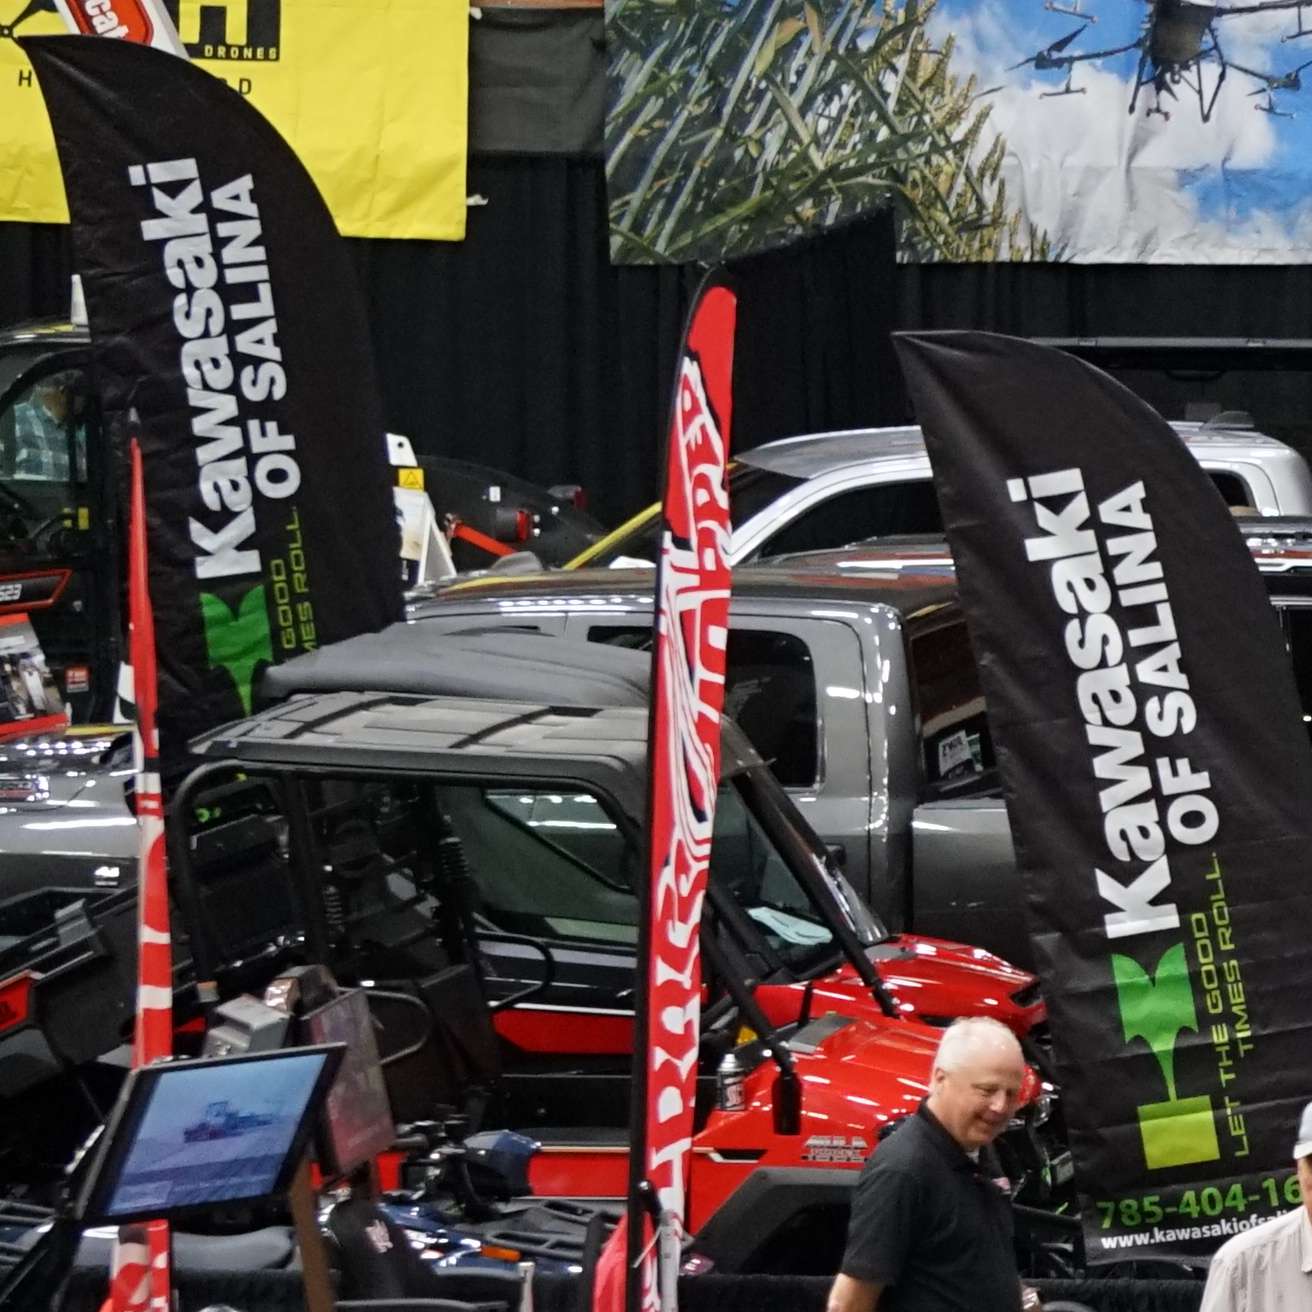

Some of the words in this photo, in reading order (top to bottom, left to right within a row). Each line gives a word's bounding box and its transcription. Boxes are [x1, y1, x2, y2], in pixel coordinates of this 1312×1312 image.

[204, 44, 277, 59] DRONES
[211, 173, 288, 401] SALINA
[128, 157, 261, 580] Kawasaki
[245, 419, 301, 499] OF
[270, 558, 297, 649] GOOD
[1099, 480, 1197, 739] SALINA
[1006, 467, 1181, 940] Kawasaki
[1153, 755, 1220, 846] OF
[1203, 851, 1237, 956] ROLL.
[1189, 912, 1224, 1010] GOOD
[1217, 1016, 1237, 1088] THE
[1220, 966, 1255, 1060] TIMES
[1233, 1104, 1251, 1157] LET
[1097, 1175, 1303, 1230] 785-404-16
